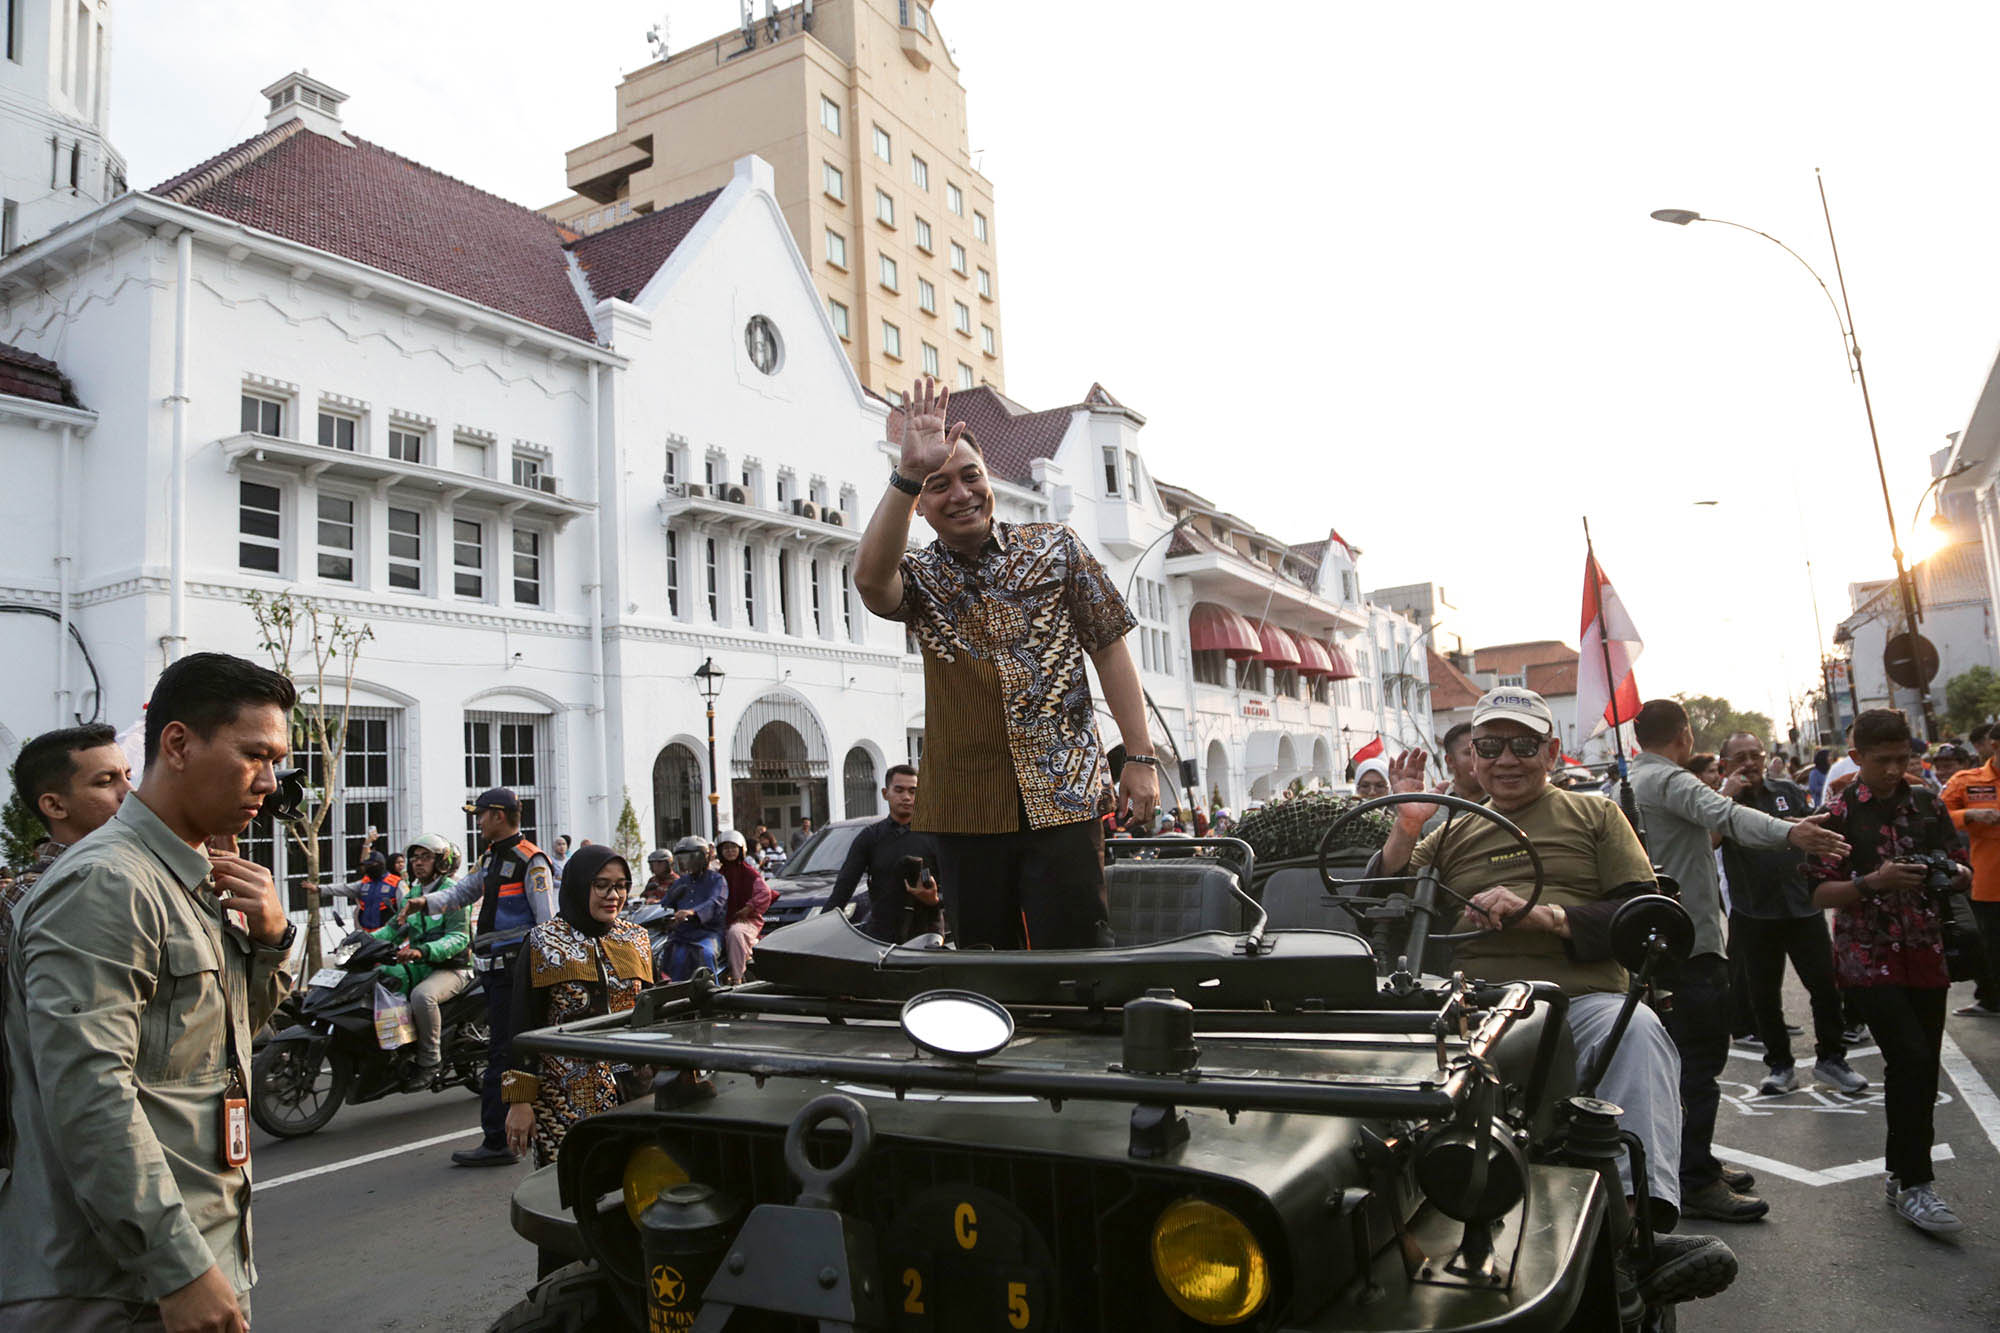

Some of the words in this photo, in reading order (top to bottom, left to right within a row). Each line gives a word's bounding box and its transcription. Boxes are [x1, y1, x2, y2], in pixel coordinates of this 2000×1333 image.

[954, 1202, 977, 1249] C
[903, 1268, 924, 1314] 2
[1008, 1282, 1030, 1330] 5
